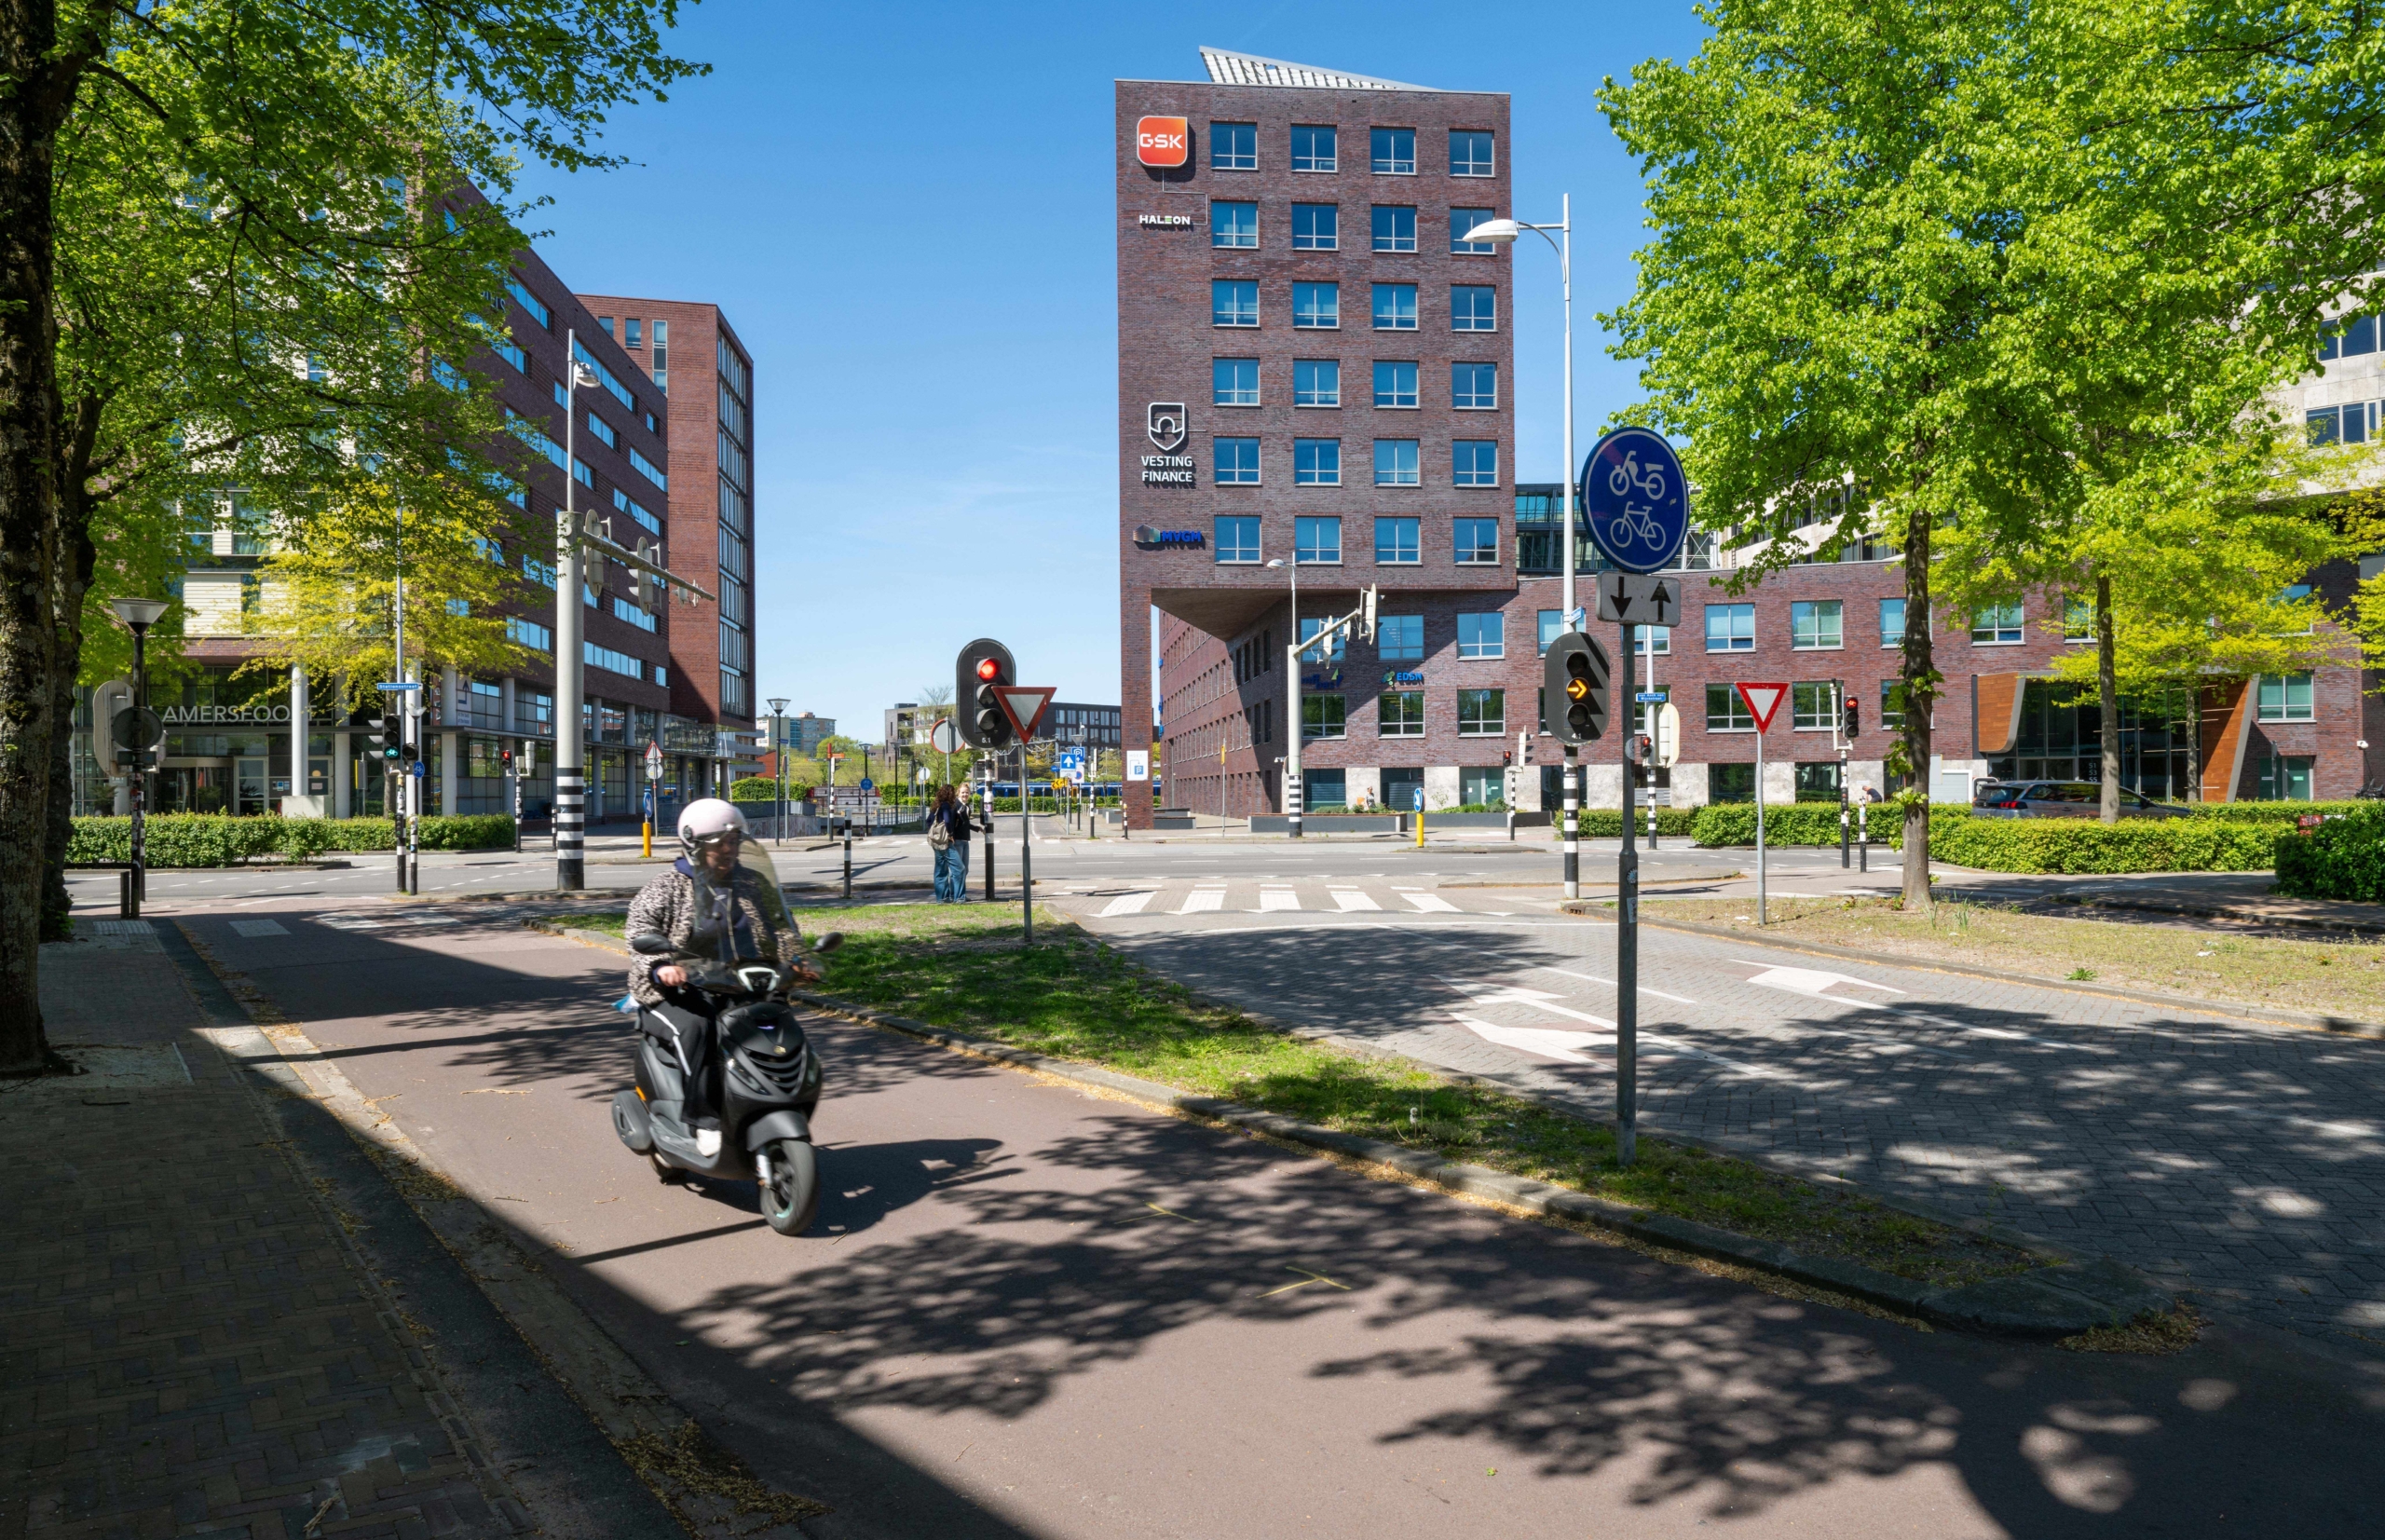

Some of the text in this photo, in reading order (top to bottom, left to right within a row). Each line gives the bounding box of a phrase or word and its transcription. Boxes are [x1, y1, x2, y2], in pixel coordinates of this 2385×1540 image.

[1139, 133, 1183, 149] GSK
[1138, 214, 1191, 225] HALEON
[1141, 456, 1192, 467] VESTING
[1141, 470, 1192, 483] FINANCE
[1162, 530, 1202, 542] MVGM
[1397, 672, 1423, 682] EDSN
[162, 704, 318, 722] AMERSFOOT
